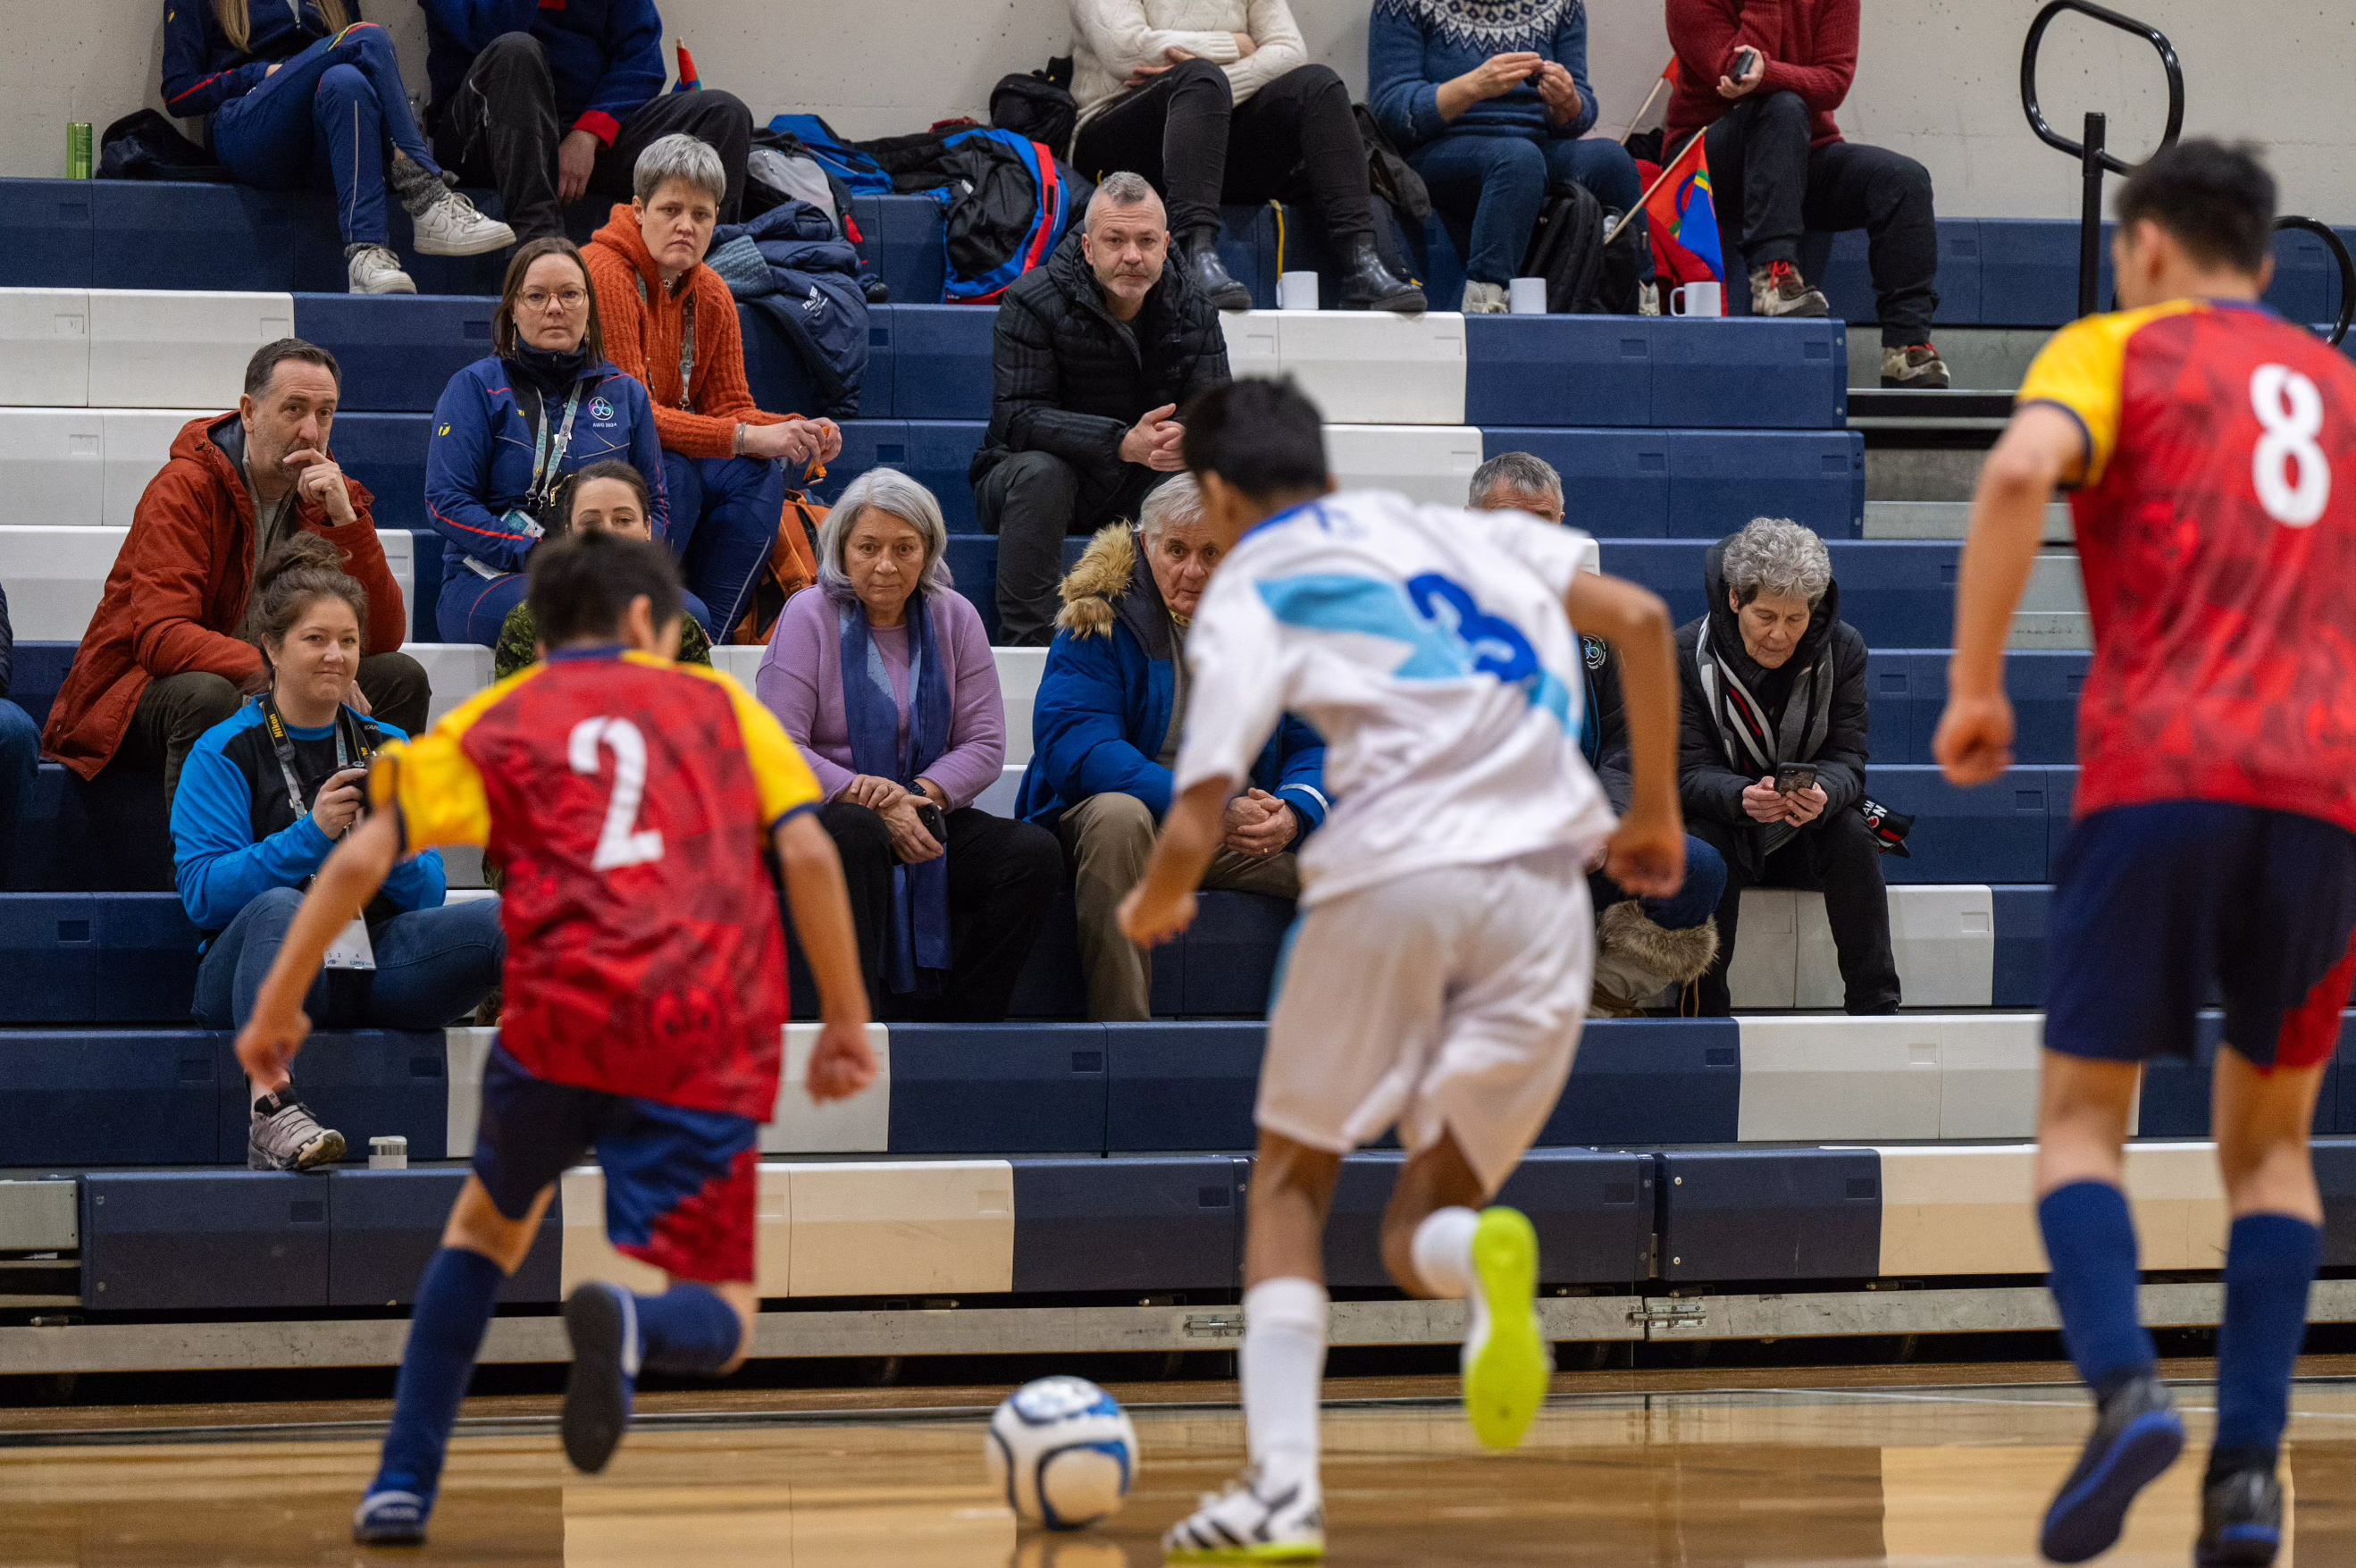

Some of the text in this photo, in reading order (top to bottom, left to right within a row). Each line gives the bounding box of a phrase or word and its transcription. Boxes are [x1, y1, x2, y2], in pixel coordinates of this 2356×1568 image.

[2249, 363, 2332, 525] 8
[1407, 572, 1539, 683] 3
[270, 714, 283, 738] Nikon
[567, 717, 665, 872] 2
